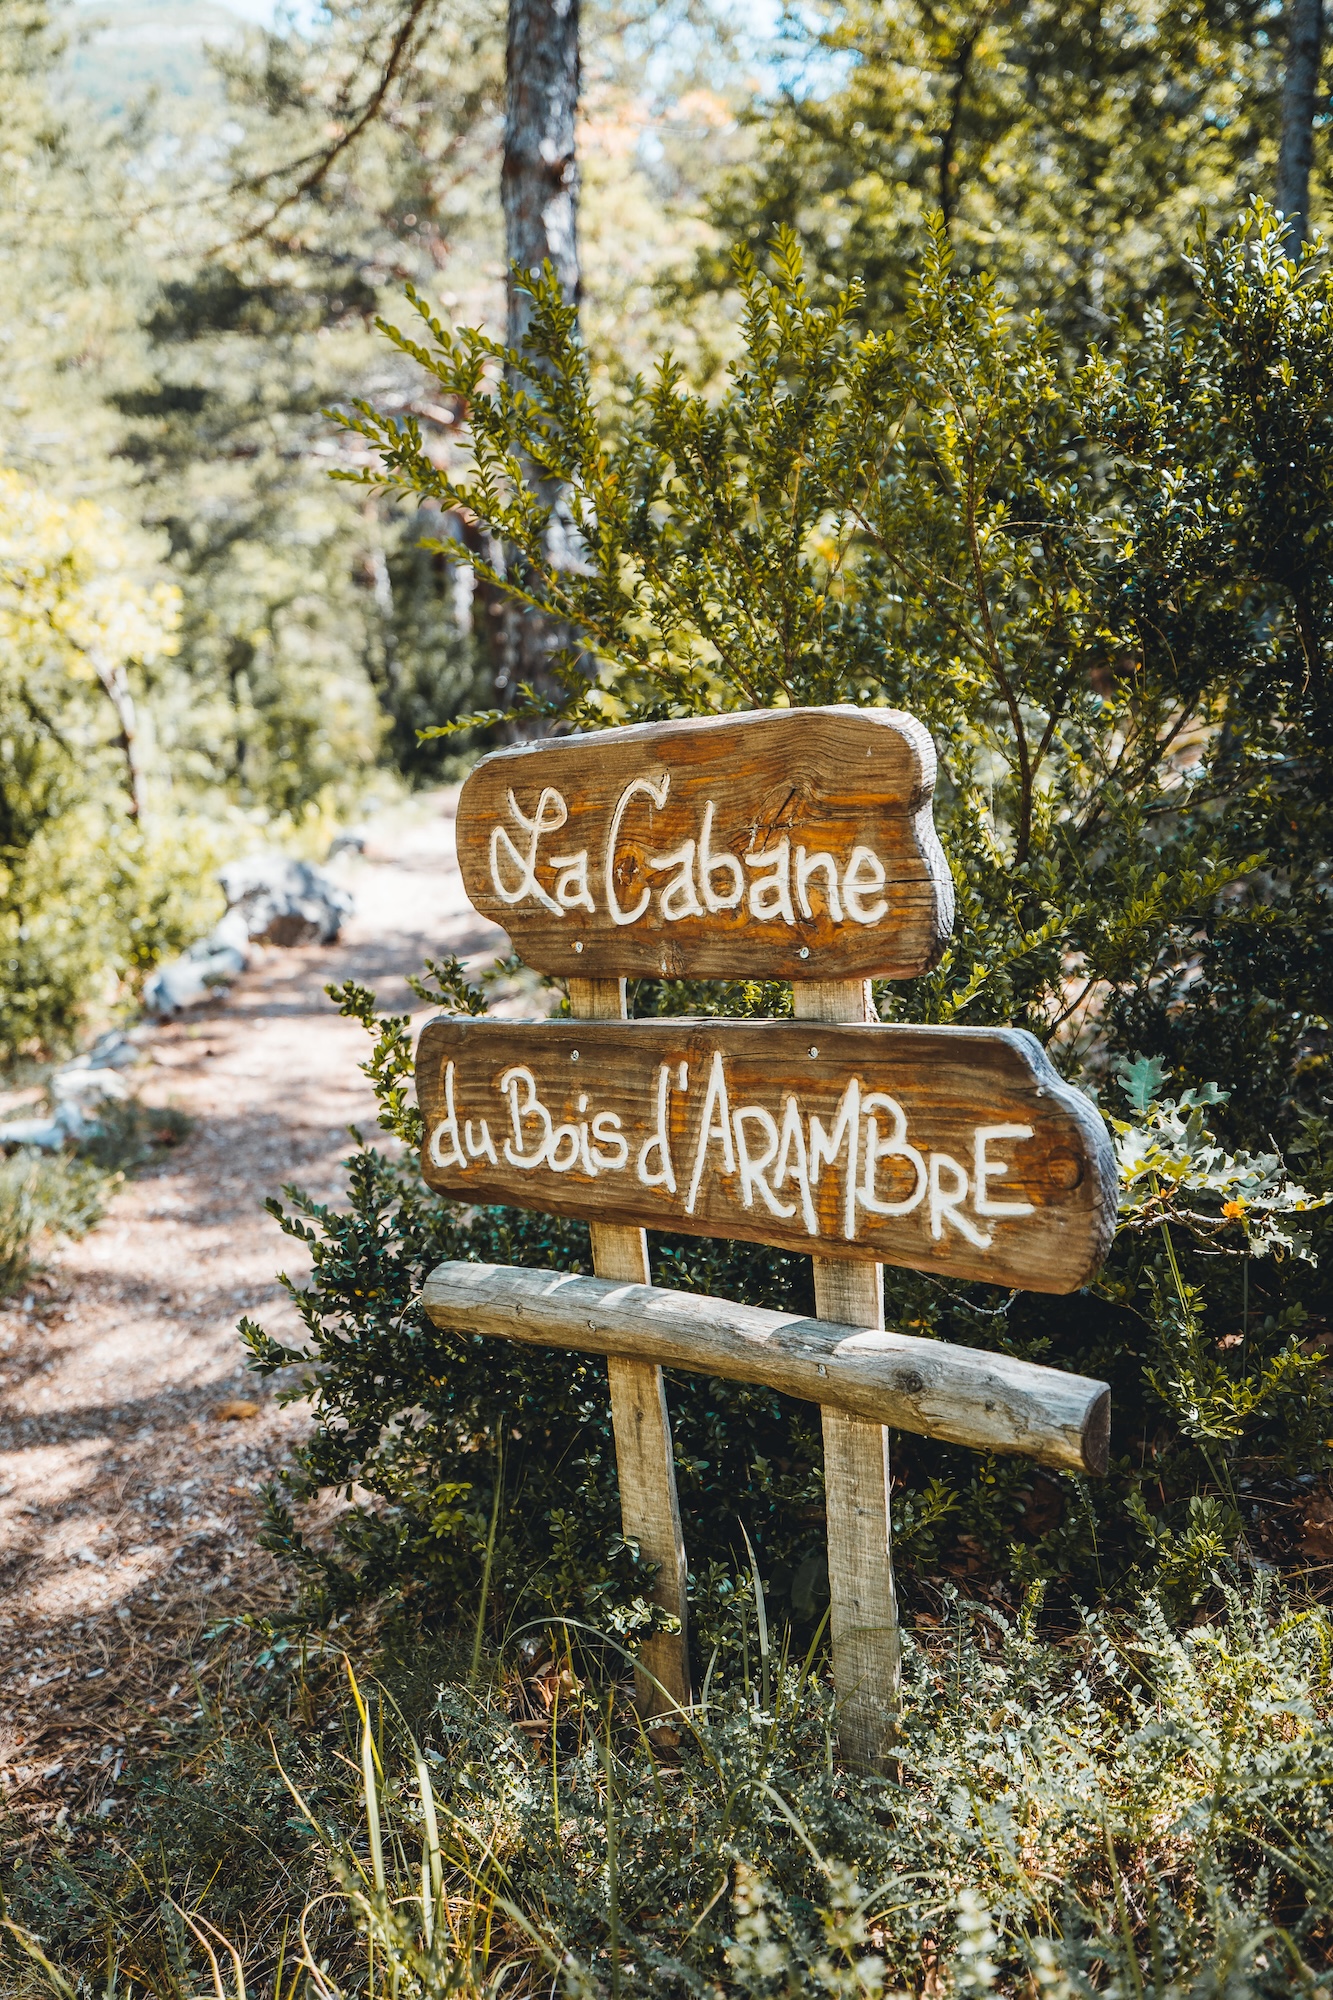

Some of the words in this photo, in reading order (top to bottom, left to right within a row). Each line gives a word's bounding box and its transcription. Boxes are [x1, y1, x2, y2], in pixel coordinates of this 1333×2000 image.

[489, 786, 595, 917] La
[605, 769, 889, 925] Cabane
[430, 1060, 497, 1168] du
[501, 1065, 629, 1176] Bois
